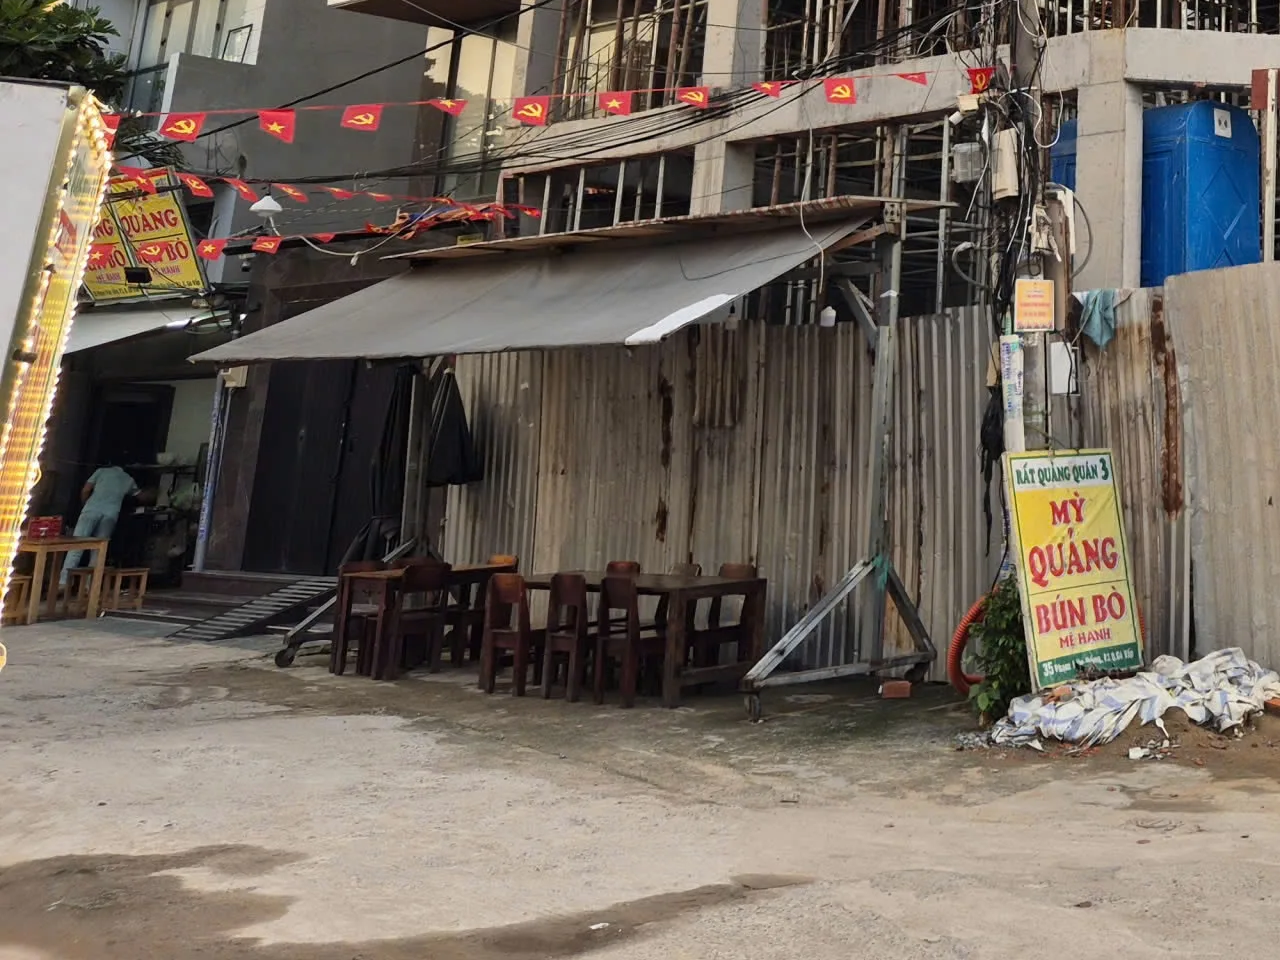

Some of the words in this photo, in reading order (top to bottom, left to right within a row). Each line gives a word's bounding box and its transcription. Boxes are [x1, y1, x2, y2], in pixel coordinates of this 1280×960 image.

[1099, 458, 1109, 480] 3
[1049, 491, 1086, 526] MỲ
[1028, 527, 1119, 588] QUẢNG
[1035, 594, 1086, 636] BÚN
[1092, 586, 1127, 624] BÒ
[1042, 661, 1055, 677] 35
